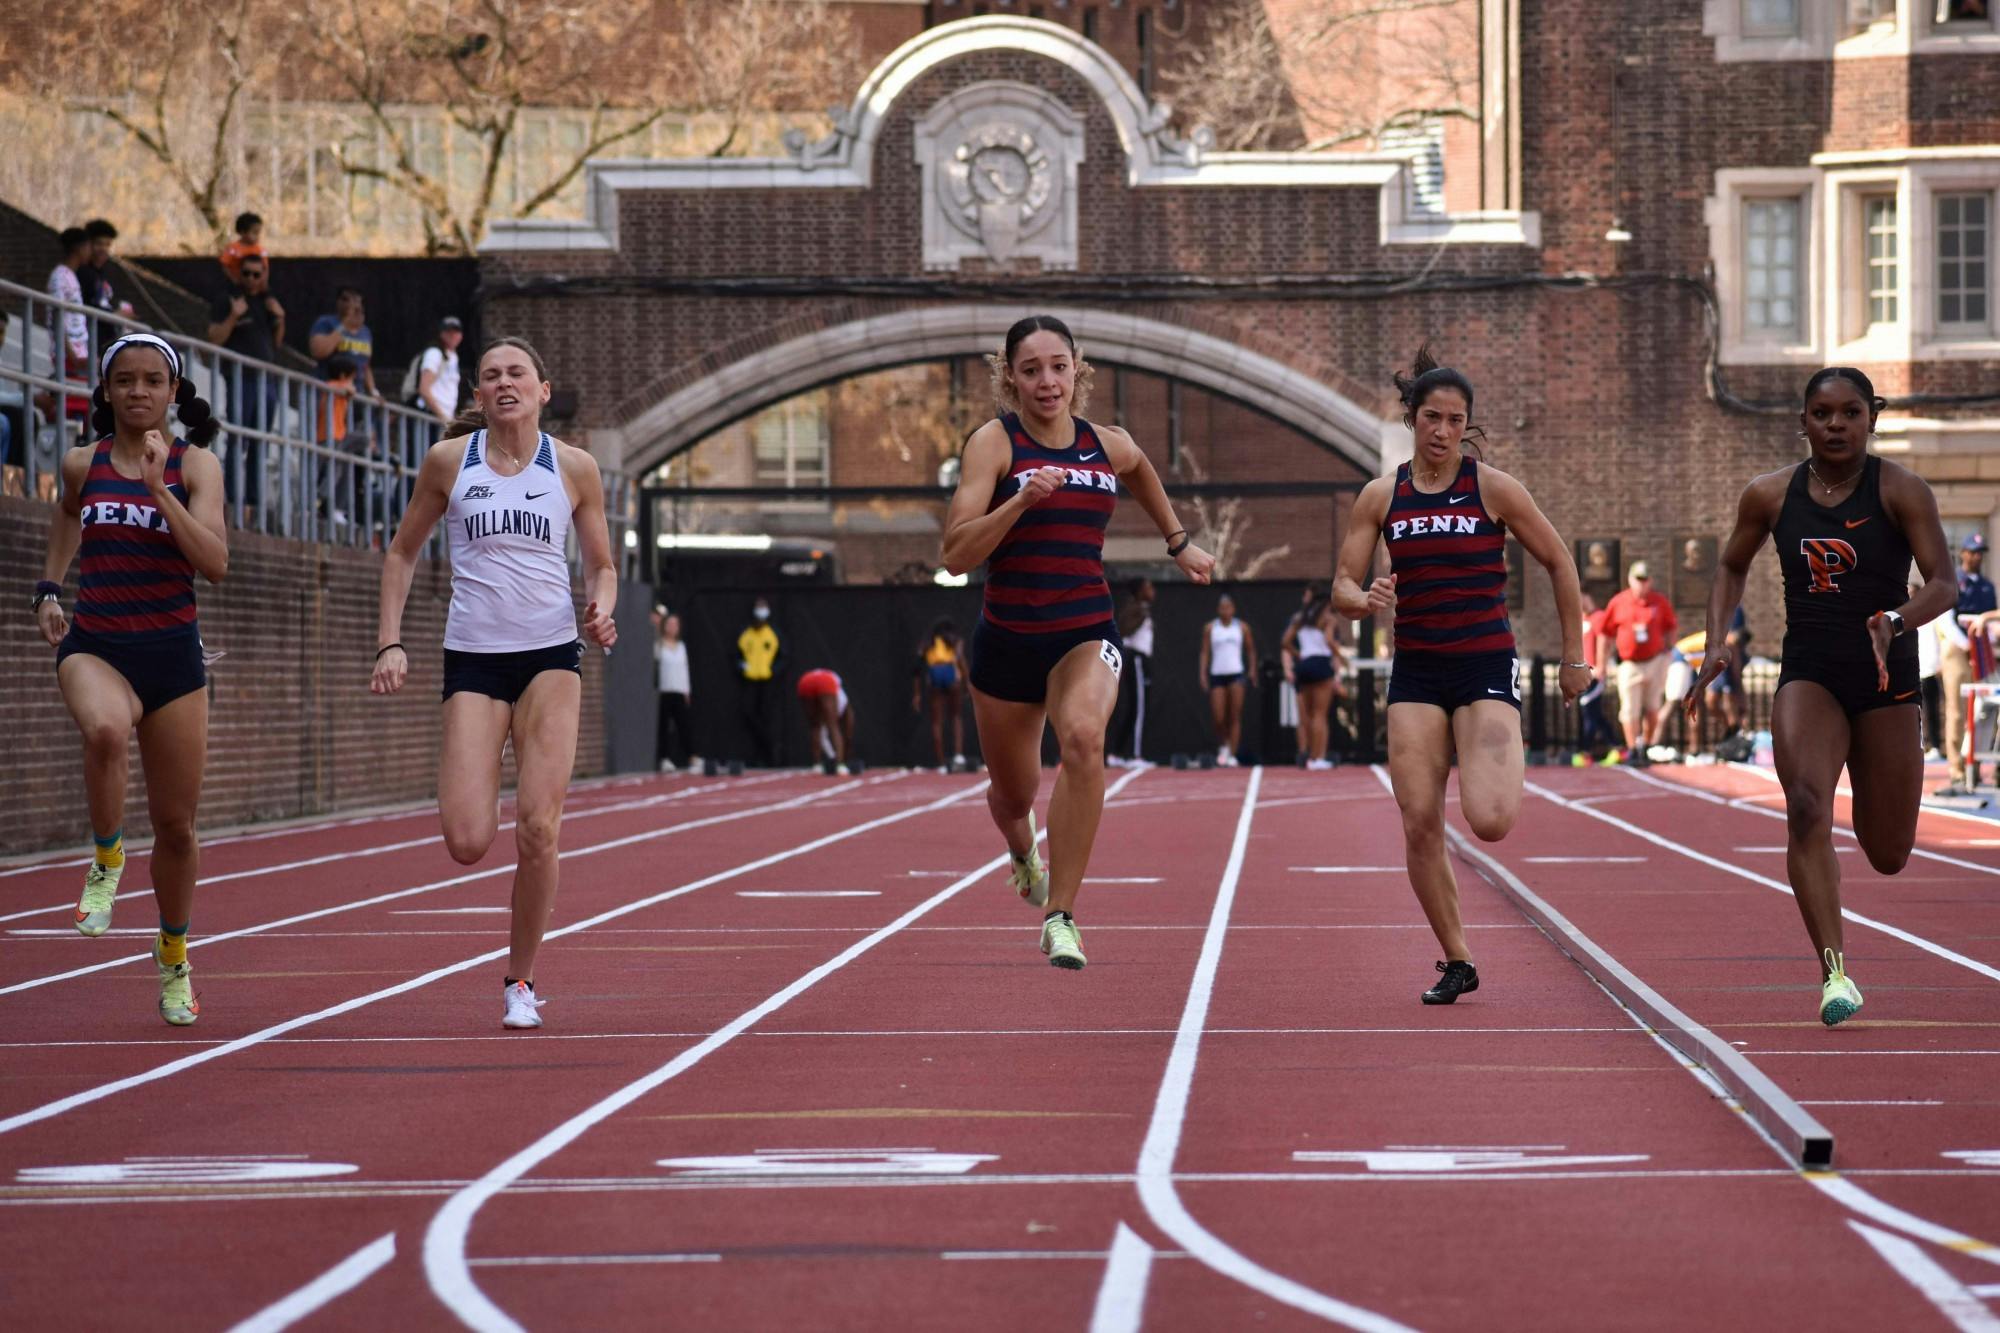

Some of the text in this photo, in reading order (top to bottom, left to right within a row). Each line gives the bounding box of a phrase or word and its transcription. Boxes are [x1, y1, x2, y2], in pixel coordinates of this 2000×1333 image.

[81, 501, 171, 534] PEN
[463, 509, 551, 544] VILLANOVA
[1391, 514, 1480, 541] PENN
[1800, 538, 1858, 593] P
